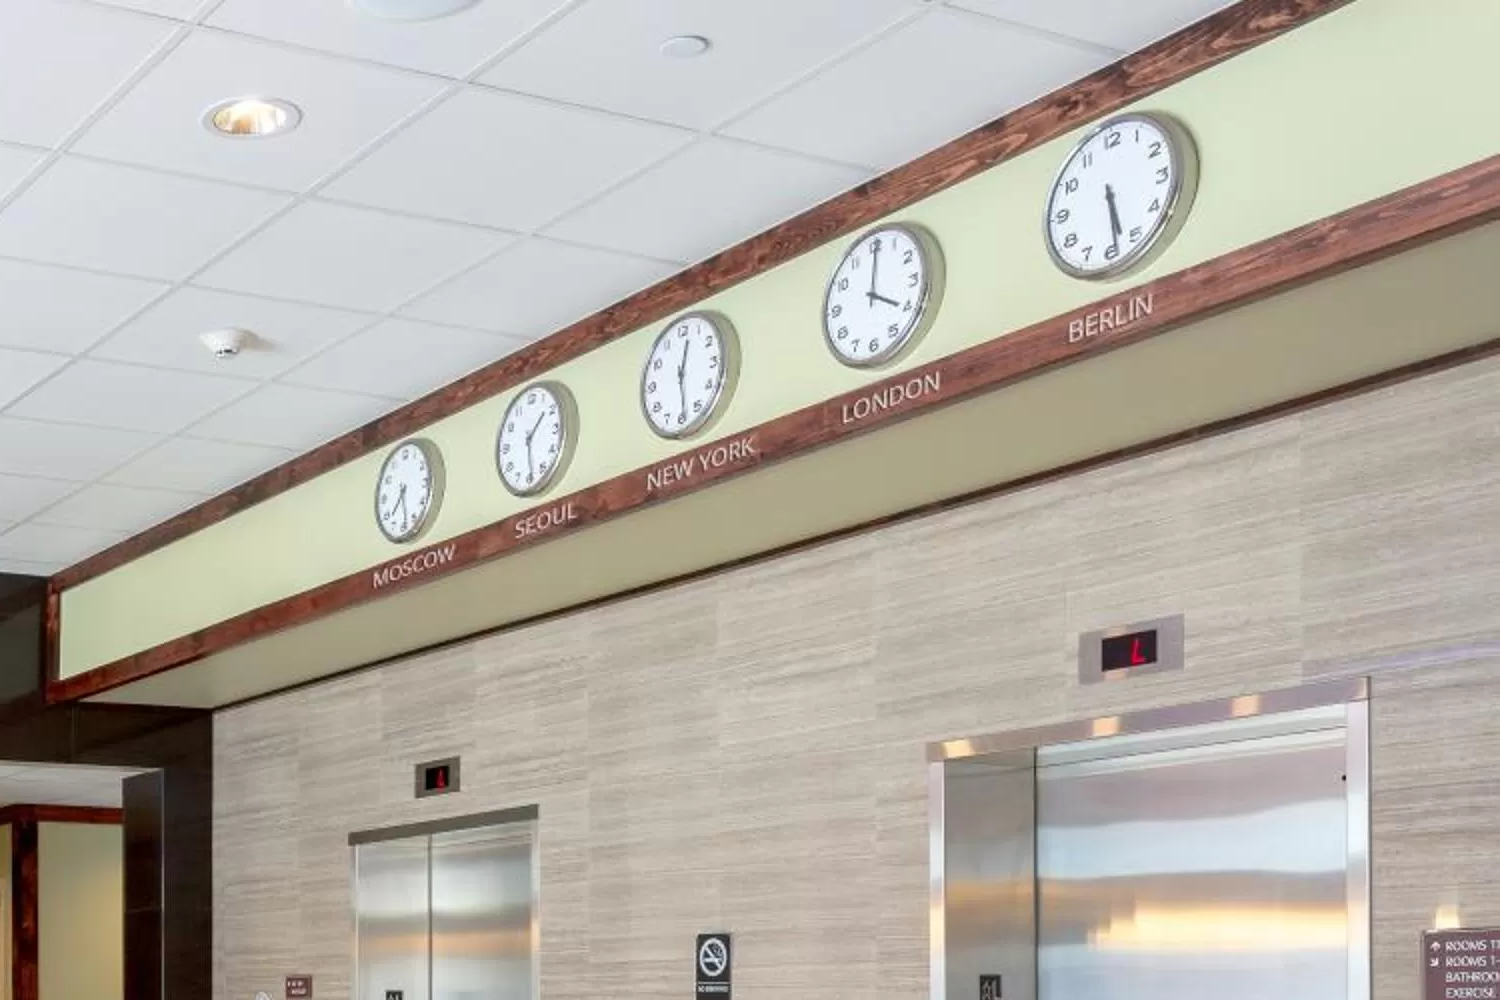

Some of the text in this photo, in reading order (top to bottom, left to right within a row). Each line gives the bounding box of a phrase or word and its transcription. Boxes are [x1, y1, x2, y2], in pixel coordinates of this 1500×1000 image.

[1103, 132, 1123, 150] 12
[1134, 129, 1141, 143] 1
[1148, 141, 1162, 158] 2
[1082, 152, 1093, 168] 11
[1155, 167, 1169, 185] 3
[1064, 178, 1079, 195] 10
[1147, 199, 1160, 213] 4
[1055, 209, 1070, 225] 9
[1063, 233, 1079, 248] 8
[1129, 227, 1142, 243] 5
[892, 237, 897, 249] 1
[903, 250, 913, 265] 2
[1081, 245, 1093, 262] 7
[1104, 243, 1120, 260] 6
[851, 256, 861, 269] 11
[837, 277, 849, 292] 10
[908, 272, 919, 287] 3
[831, 305, 842, 318] 9
[902, 299, 912, 312] 4
[1068, 293, 1153, 343] BERLIN
[837, 326, 849, 340] 8
[887, 323, 899, 339] 5
[851, 339, 860, 352] 7
[868, 338, 879, 353] 6
[841, 371, 941, 425] LONDON
[646, 437, 756, 491] NEW YORK
[515, 502, 578, 540] SEOUL
[372, 543, 457, 590] MOSCOW
[1131, 638, 1145, 665] L
[1445, 939, 1487, 952] ROOMS
[1445, 955, 1487, 967] ROOMS
[1445, 987, 1497, 998] EXERCISE
